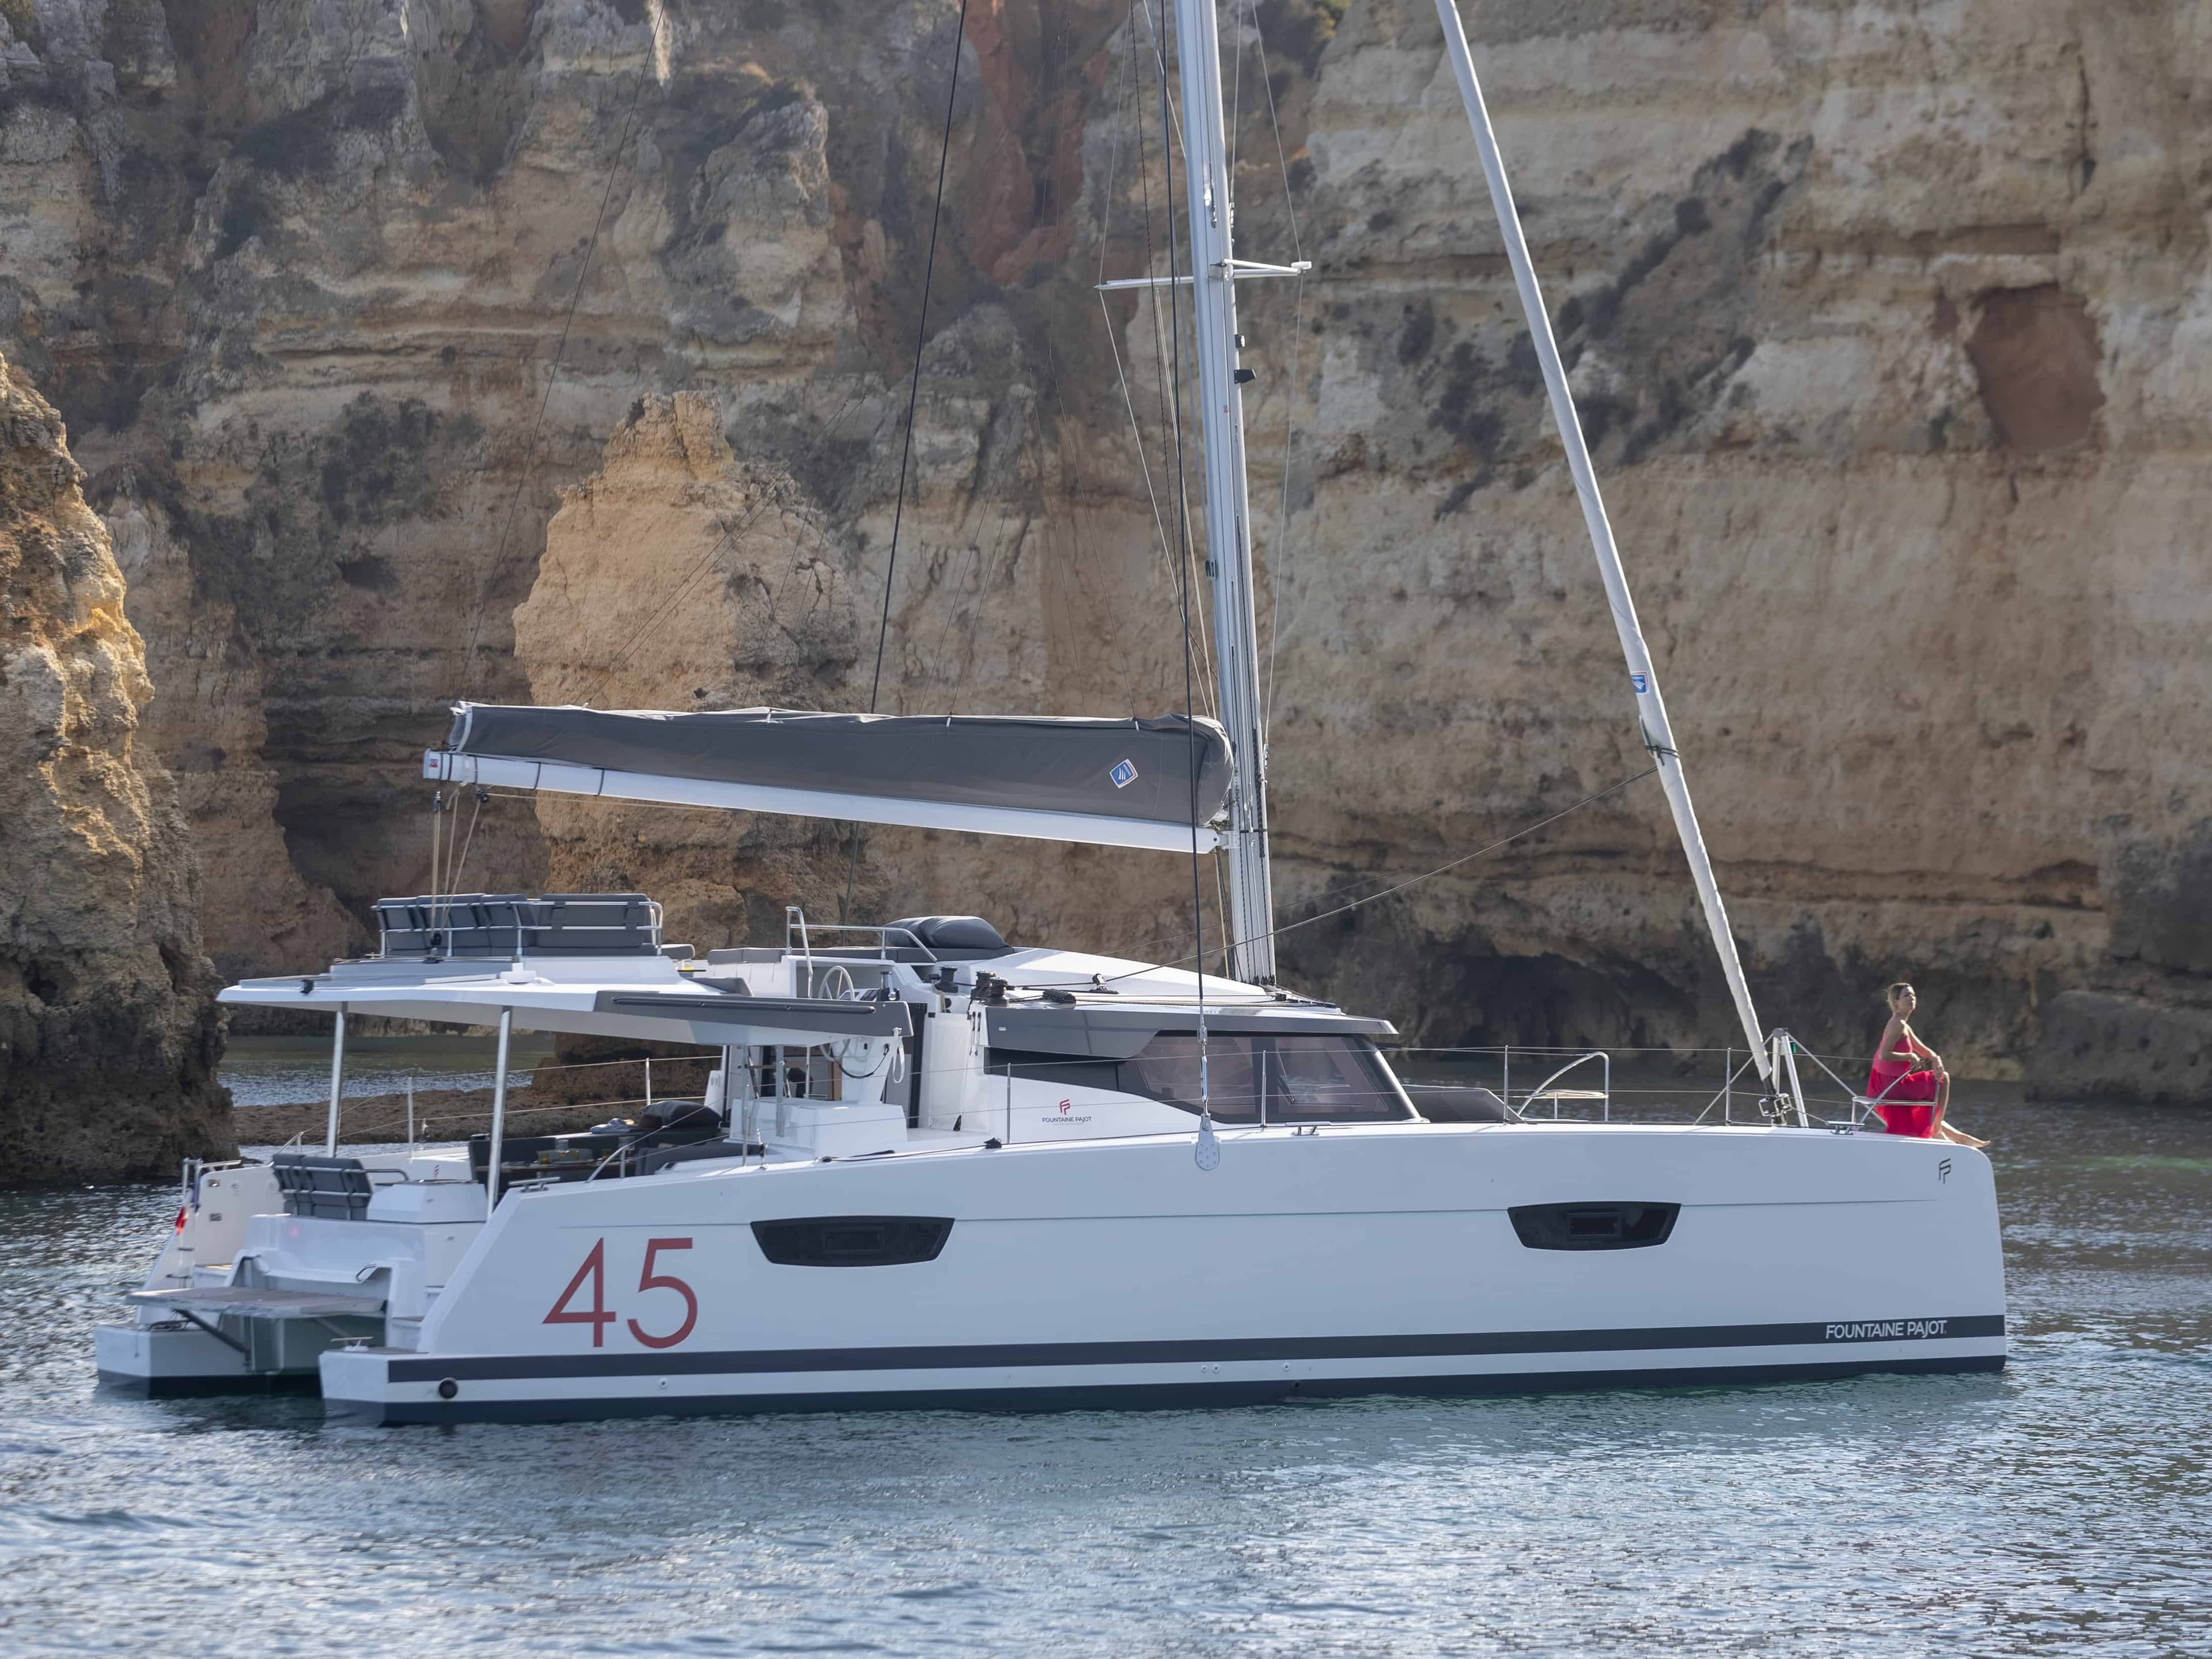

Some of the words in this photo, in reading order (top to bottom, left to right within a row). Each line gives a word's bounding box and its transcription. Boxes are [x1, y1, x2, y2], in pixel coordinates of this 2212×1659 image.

[542, 1237, 698, 1349] 45
[1825, 1323, 1904, 1339] FOUNTAINE
[1907, 1320, 1948, 1338] PAJOT
